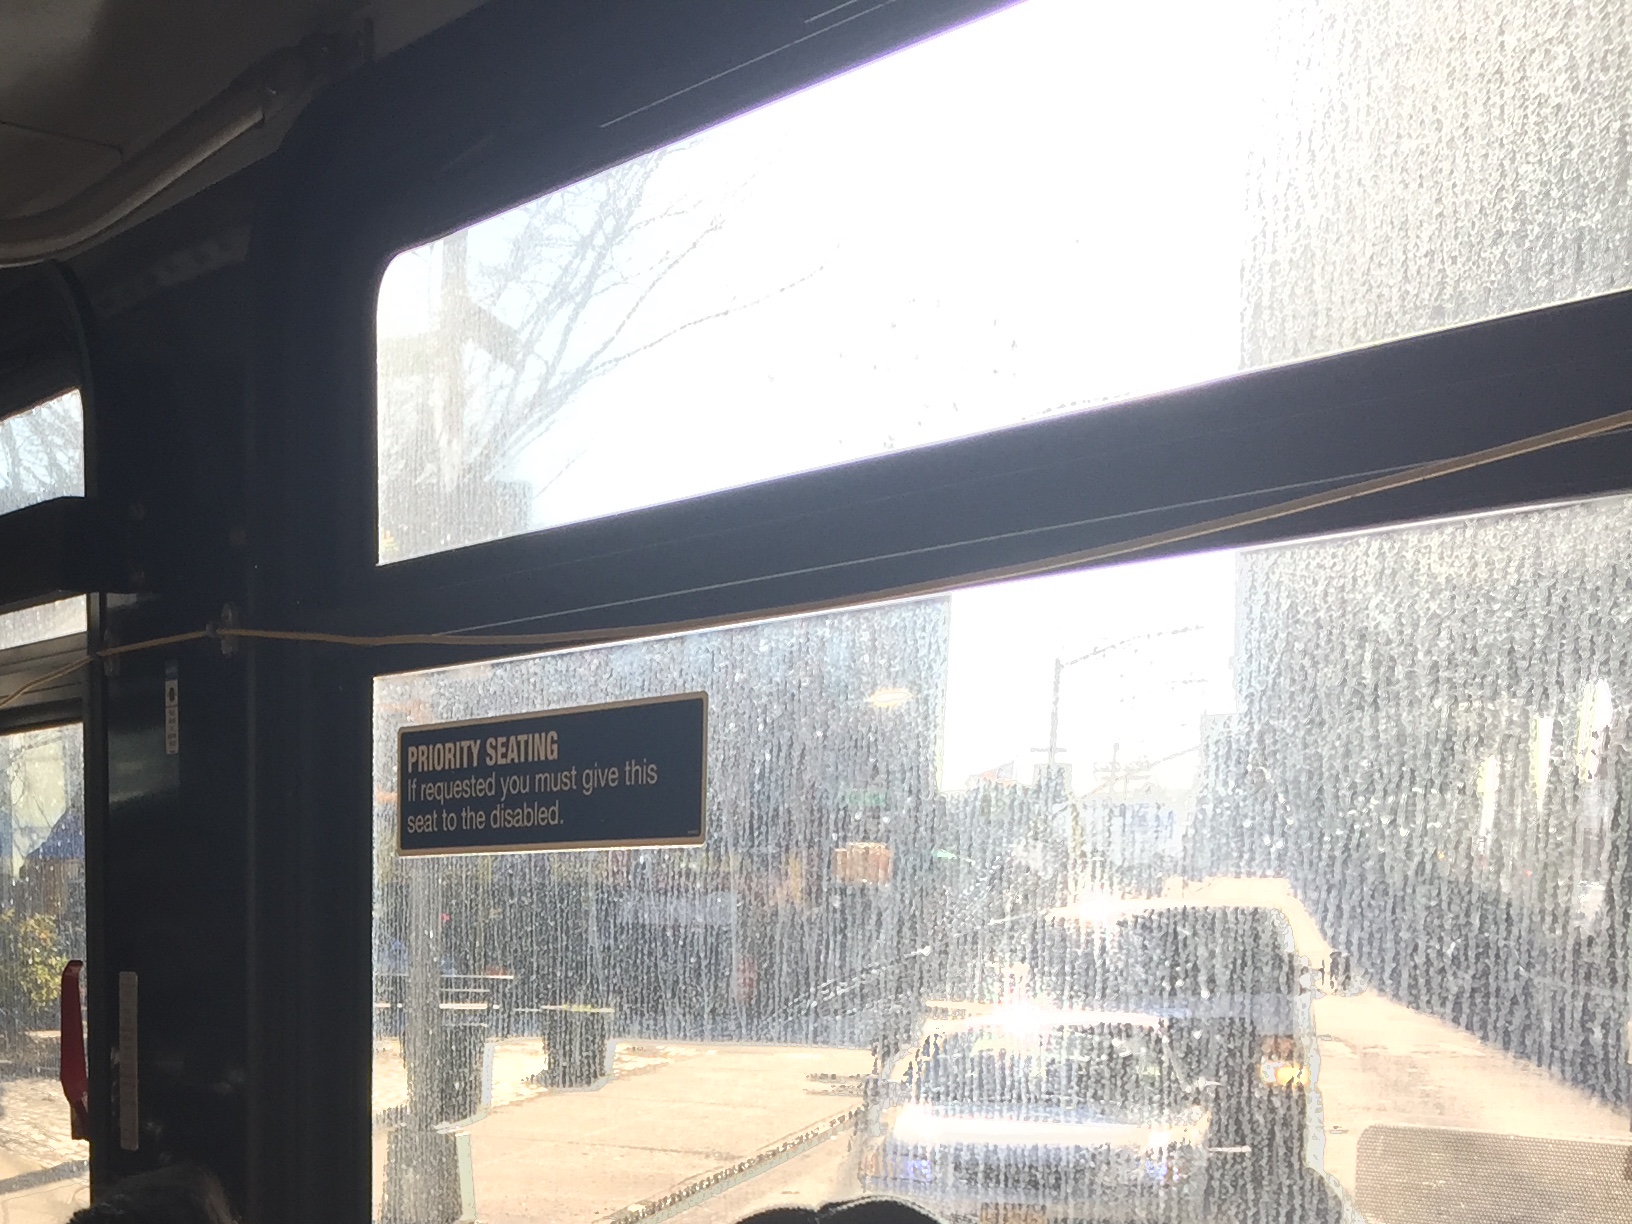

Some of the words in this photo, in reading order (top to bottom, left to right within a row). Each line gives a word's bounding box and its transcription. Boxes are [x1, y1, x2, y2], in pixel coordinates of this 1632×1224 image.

[407, 739, 481, 773] PRIORITY
[485, 730, 559, 766] SEATING
[407, 778, 419, 802] If
[421, 772, 496, 805] requested
[500, 777, 530, 800] you
[535, 765, 577, 794] must
[582, 761, 619, 795] give
[625, 758, 658, 786] this
[407, 809, 437, 834] seat
[442, 809, 456, 831] to
[461, 806, 485, 830] the
[490, 799, 564, 829] disabled.
